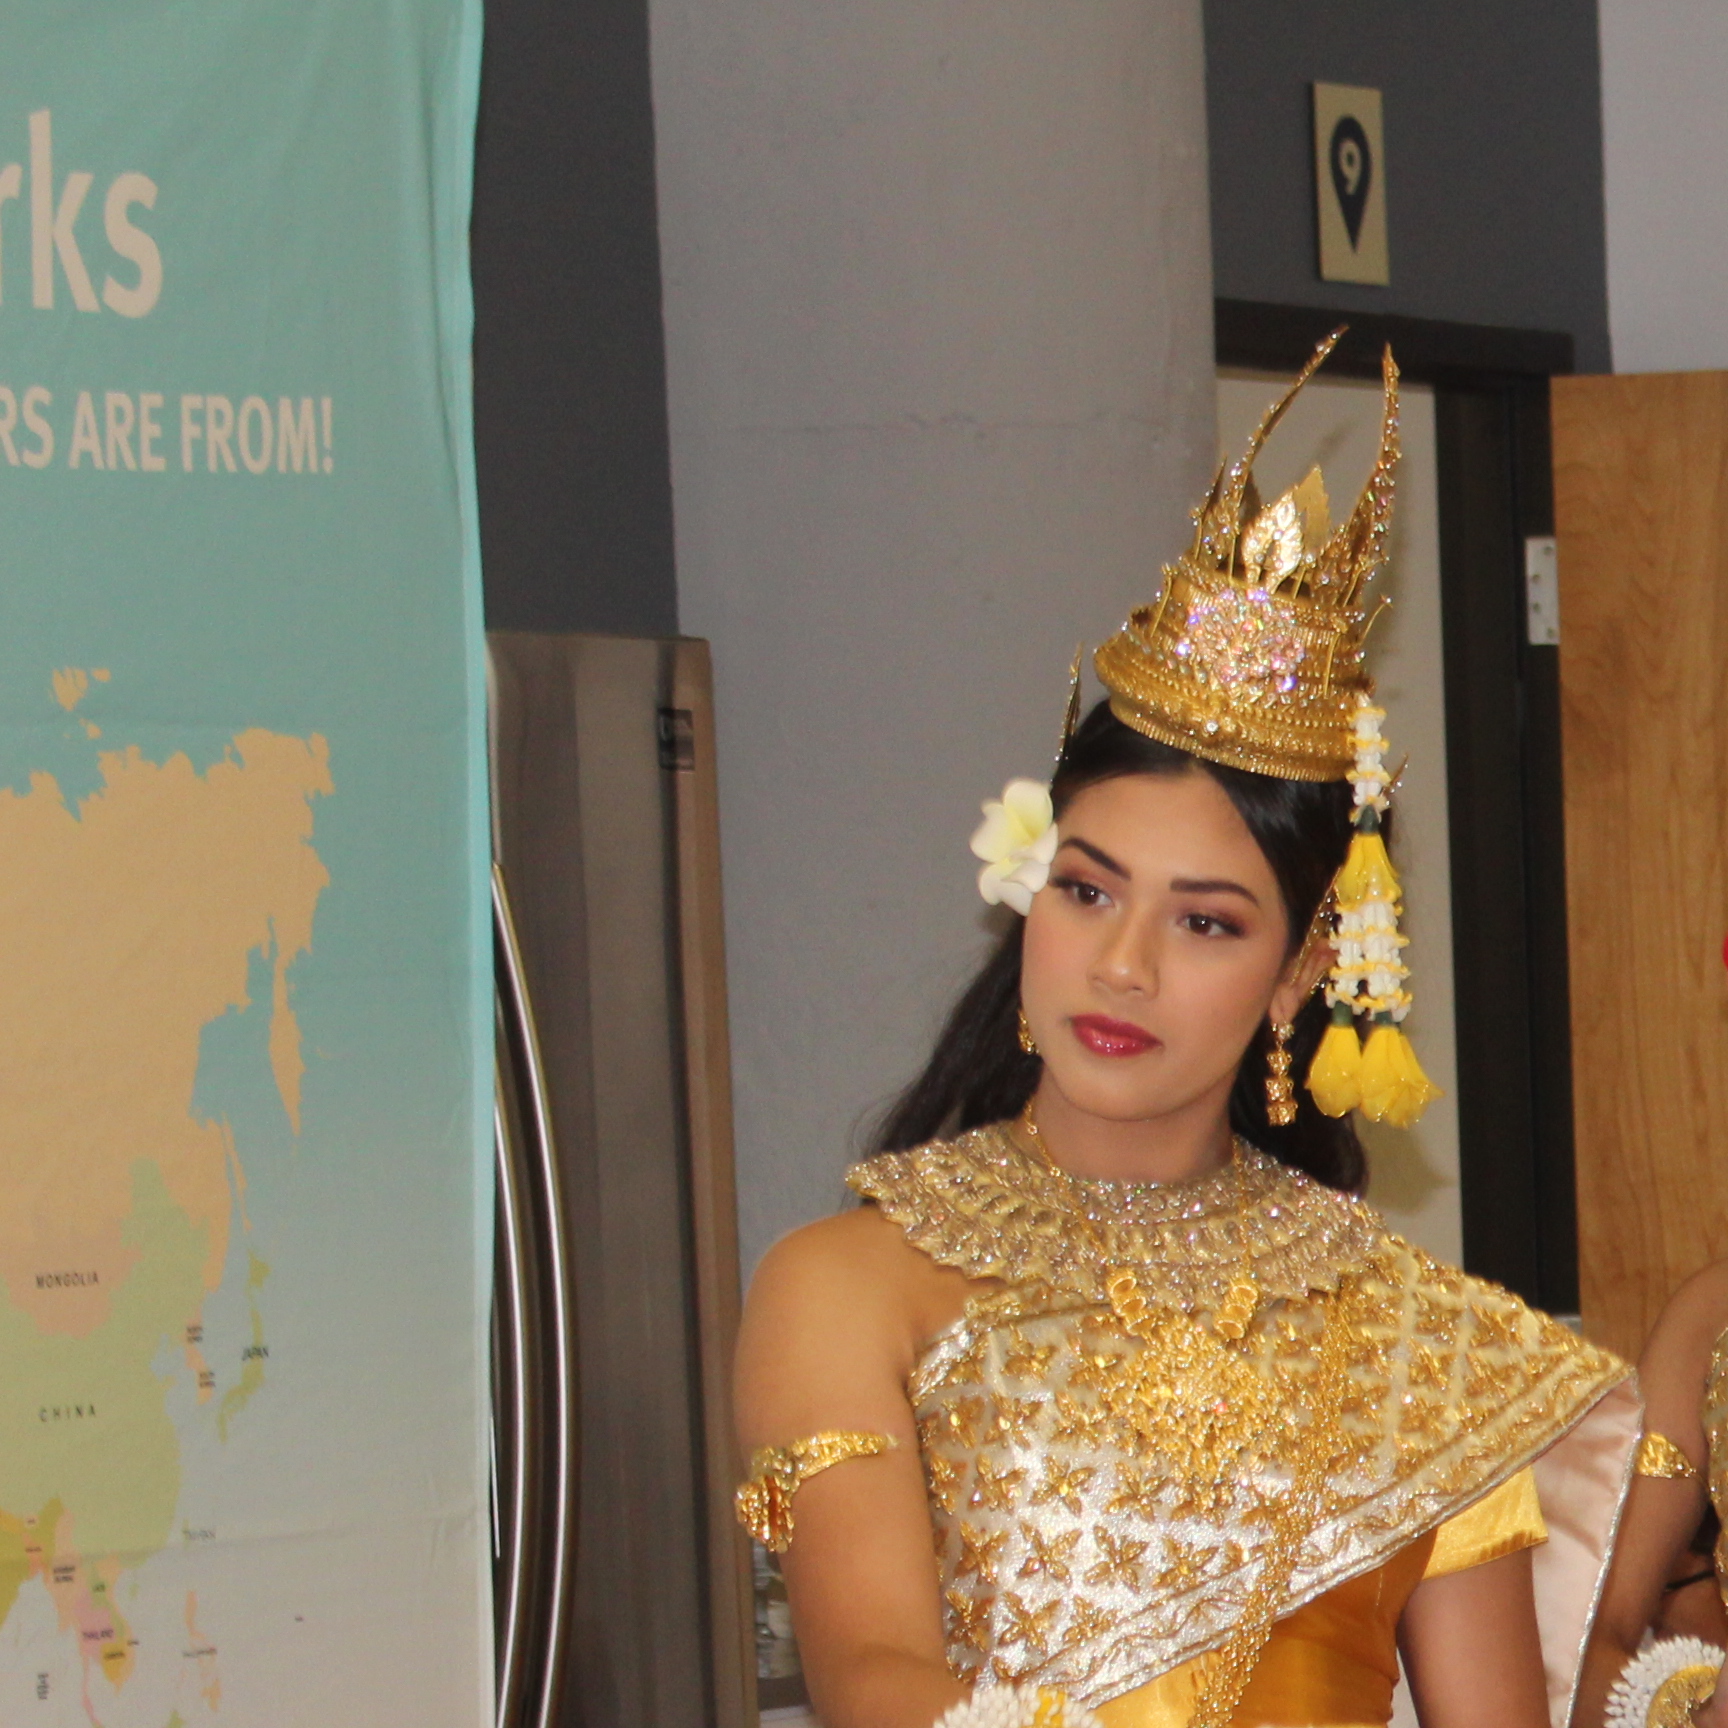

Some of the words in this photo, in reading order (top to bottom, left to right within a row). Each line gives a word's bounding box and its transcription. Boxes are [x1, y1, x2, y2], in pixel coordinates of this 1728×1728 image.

[1339, 138, 1362, 196] 9
[68, 391, 167, 473] ARE
[180, 394, 334, 475] FROM!
[36, 1271, 99, 1289] MONGOLIA
[39, 1404, 97, 1423] CHINA
